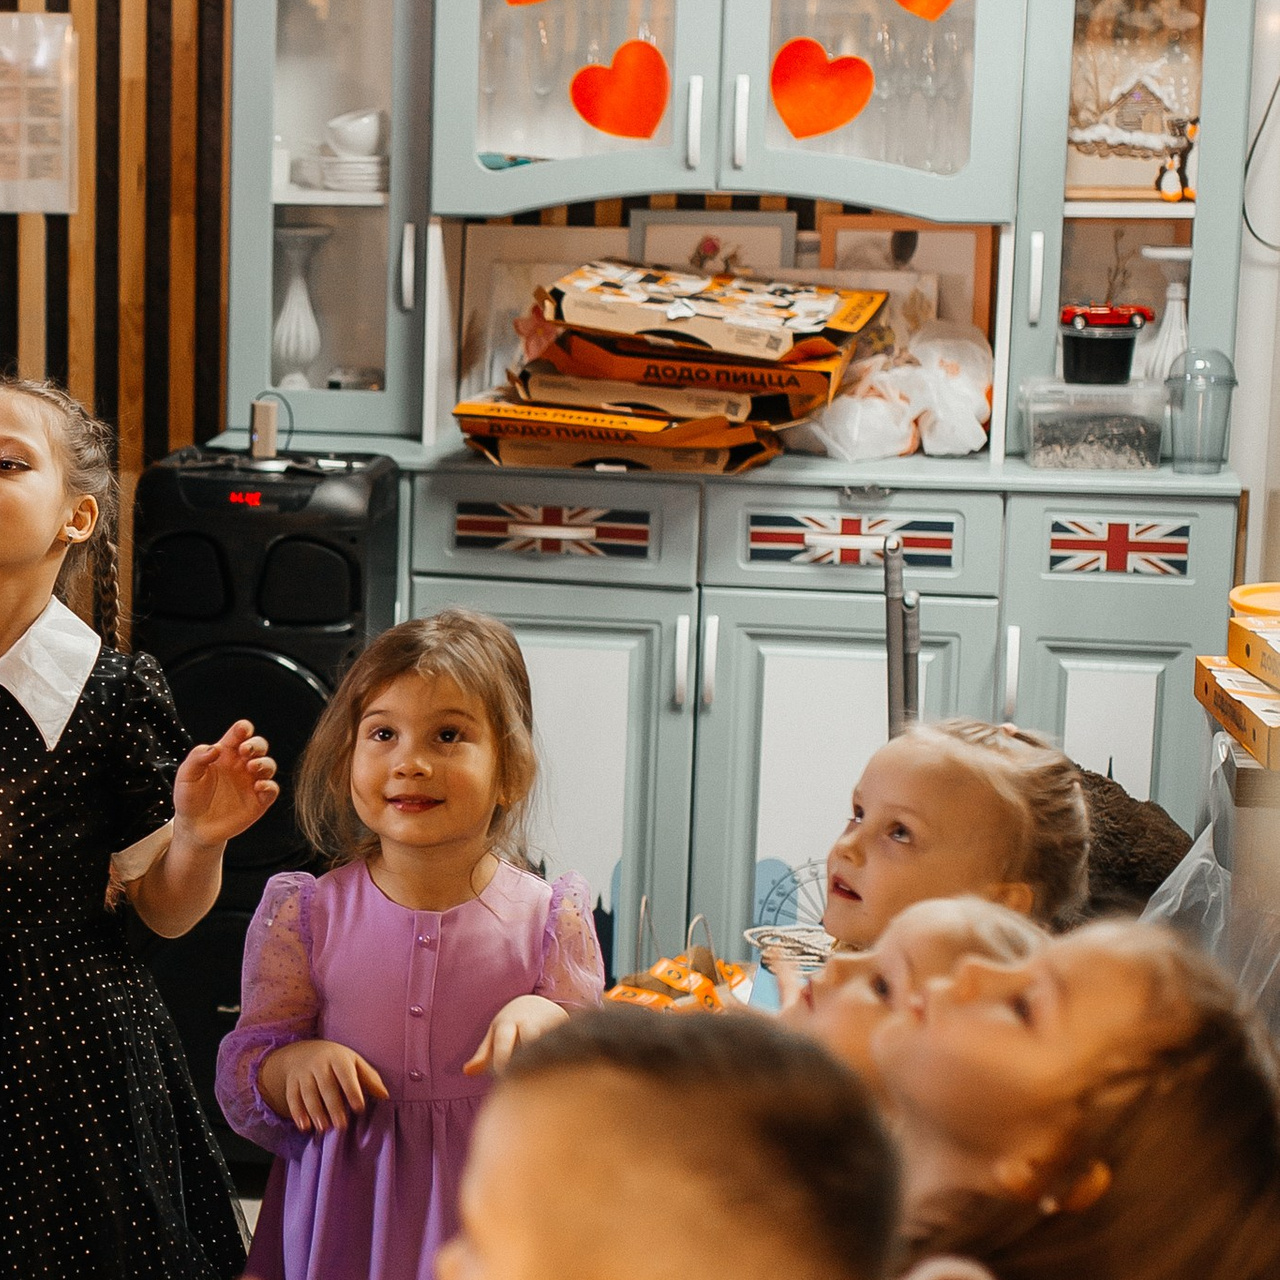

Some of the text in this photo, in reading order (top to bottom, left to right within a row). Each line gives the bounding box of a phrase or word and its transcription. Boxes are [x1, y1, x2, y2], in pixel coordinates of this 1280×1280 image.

[643, 364, 801, 388] ДОДО ПИЦЦА
[488, 422, 638, 442] ДОДО ПИЦЦА
